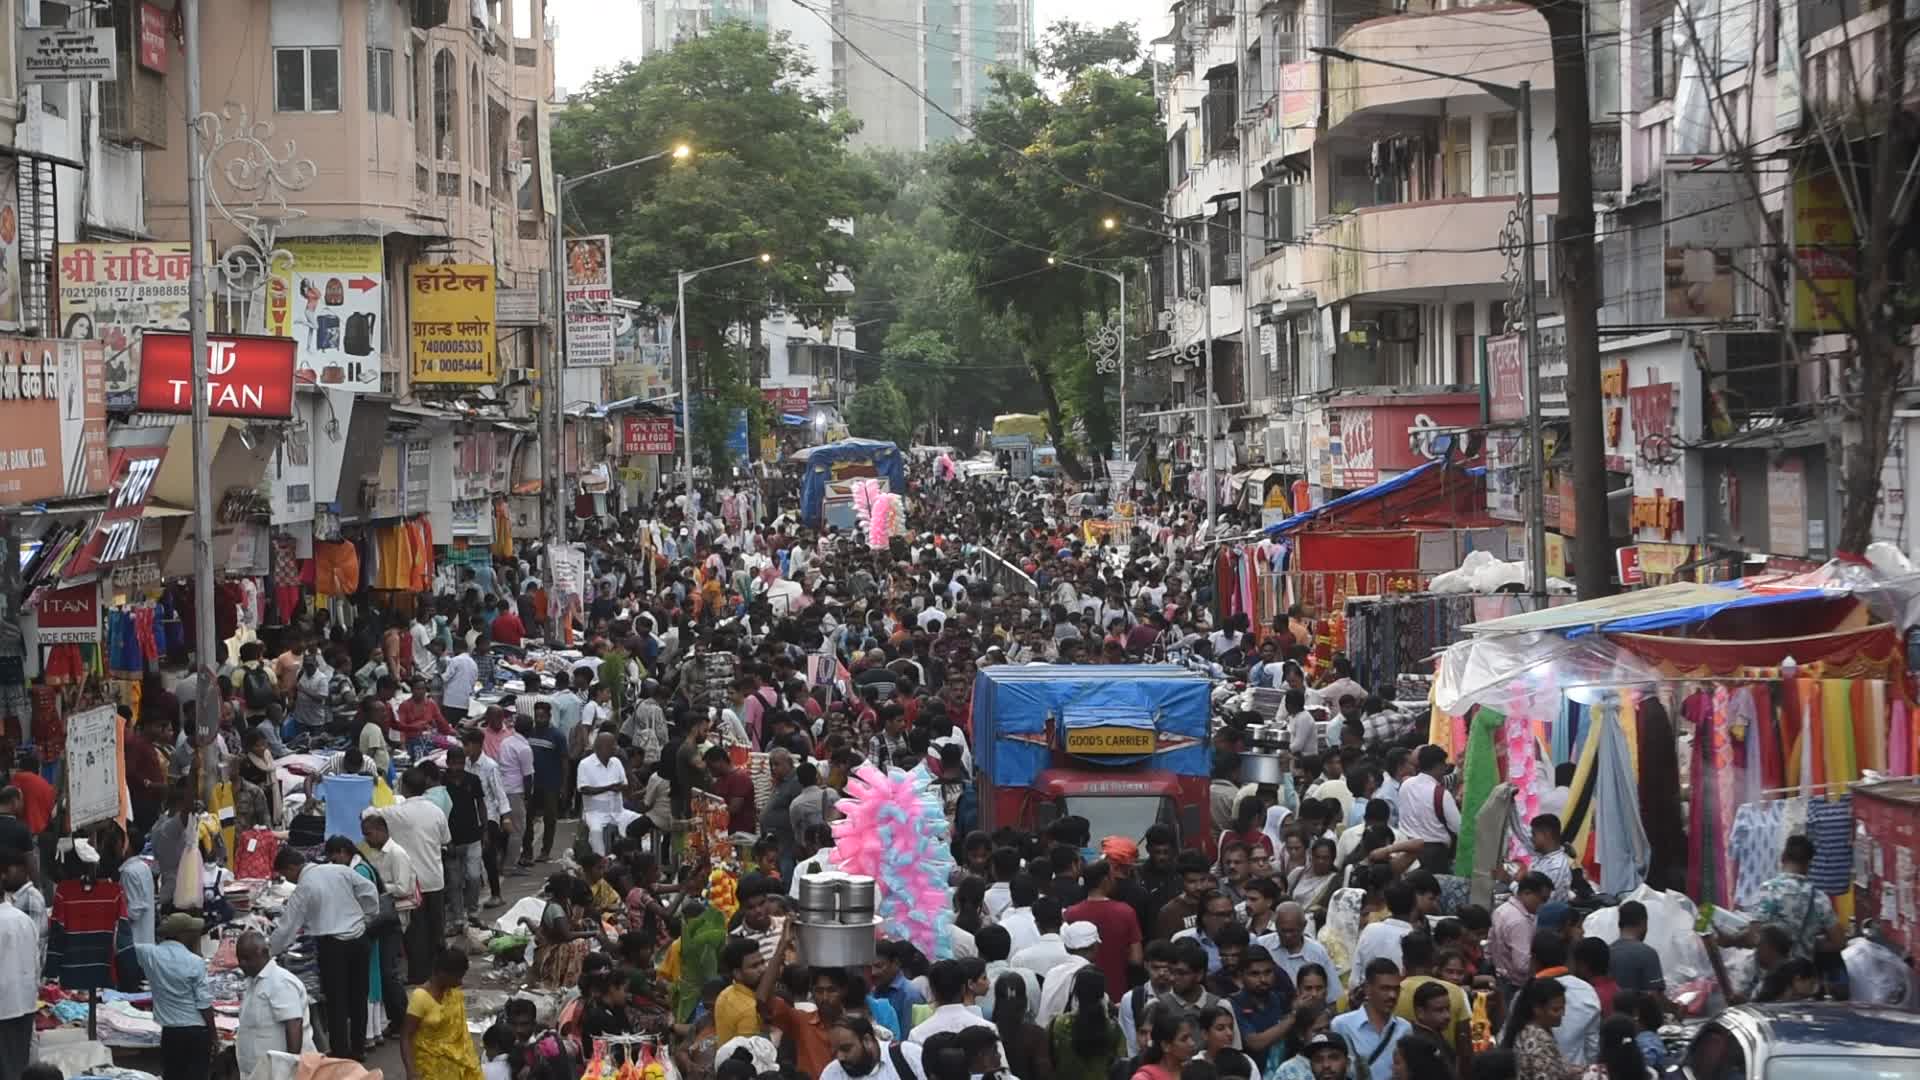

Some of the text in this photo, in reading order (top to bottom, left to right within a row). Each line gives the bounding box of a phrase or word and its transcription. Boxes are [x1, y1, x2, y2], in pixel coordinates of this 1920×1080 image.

[61, 248, 96, 282] श्री
[414, 267, 488, 293] हॉटेल
[456, 316, 490, 336] फ्लोर
[421, 360, 483, 372] 740005444
[168, 379, 264, 409] TTAN
[61, 632, 97, 641] CENTRE
[1068, 735, 1149, 747] GOODS CARRIER
